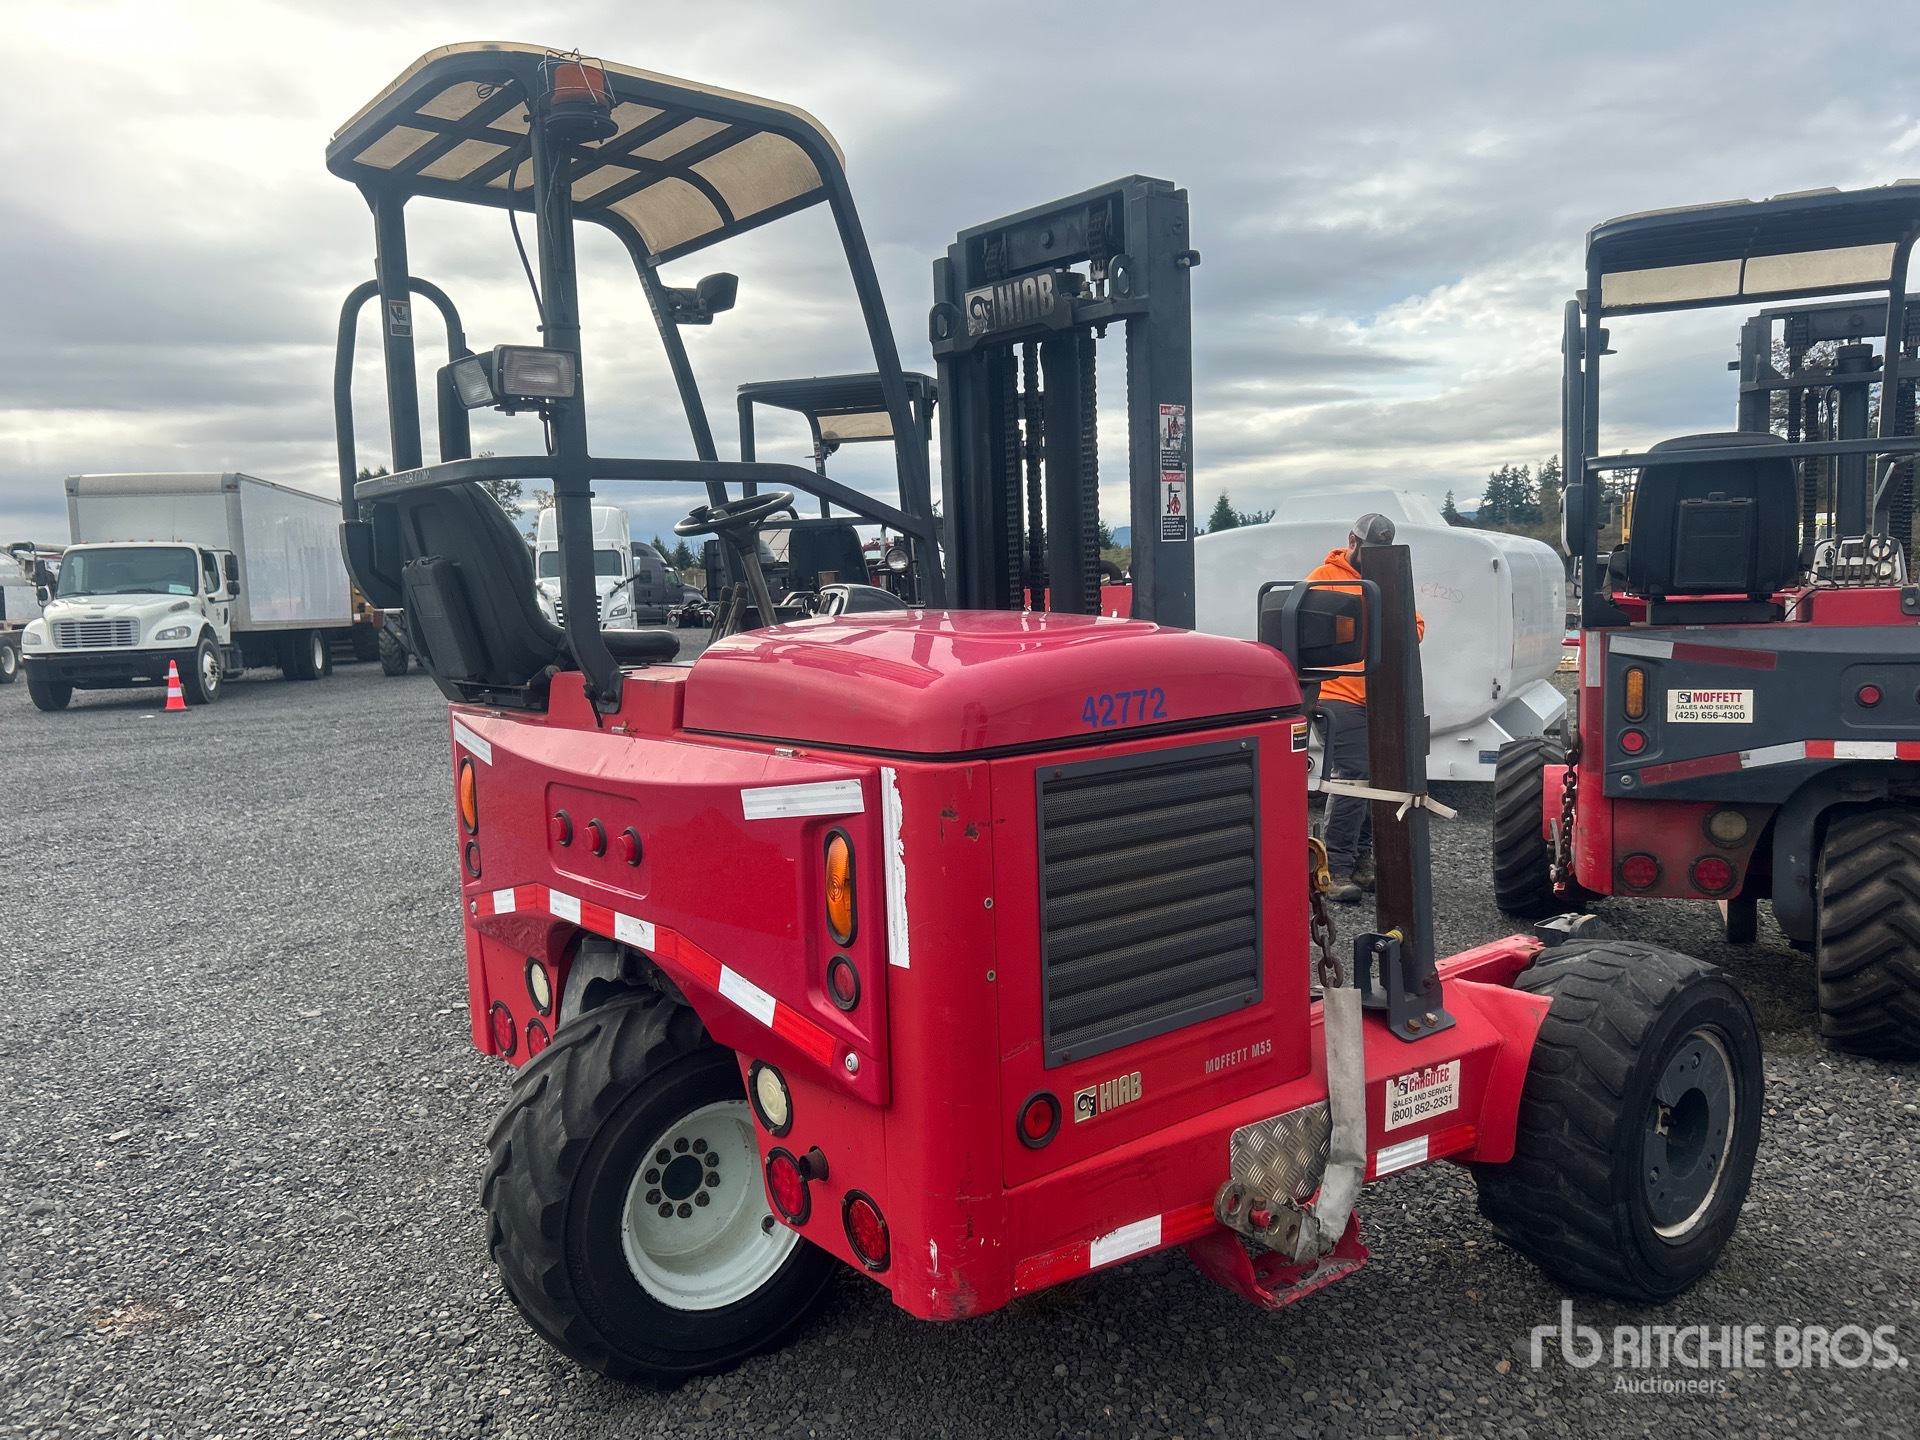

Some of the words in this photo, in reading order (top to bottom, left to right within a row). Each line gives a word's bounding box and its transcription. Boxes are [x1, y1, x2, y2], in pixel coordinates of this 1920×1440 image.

[997, 273, 1055, 326] HIAB
[1082, 687, 1168, 728] 42772
[1693, 692, 1742, 703] MOFFETT
[1674, 711, 1699, 720] (425)
[1701, 711, 1745, 719] 656-4300
[1205, 1047, 1248, 1074] MOFFETT
[1251, 1039, 1272, 1058] M55
[1099, 1071, 1143, 1113] HIAB
[1393, 1096, 1413, 1109] SALES
[1413, 1092, 1427, 1103] AND
[1427, 1083, 1453, 1098] SERVICE
[1391, 1106, 1413, 1125] (800)
[1414, 1094, 1453, 1115] 852-2331
